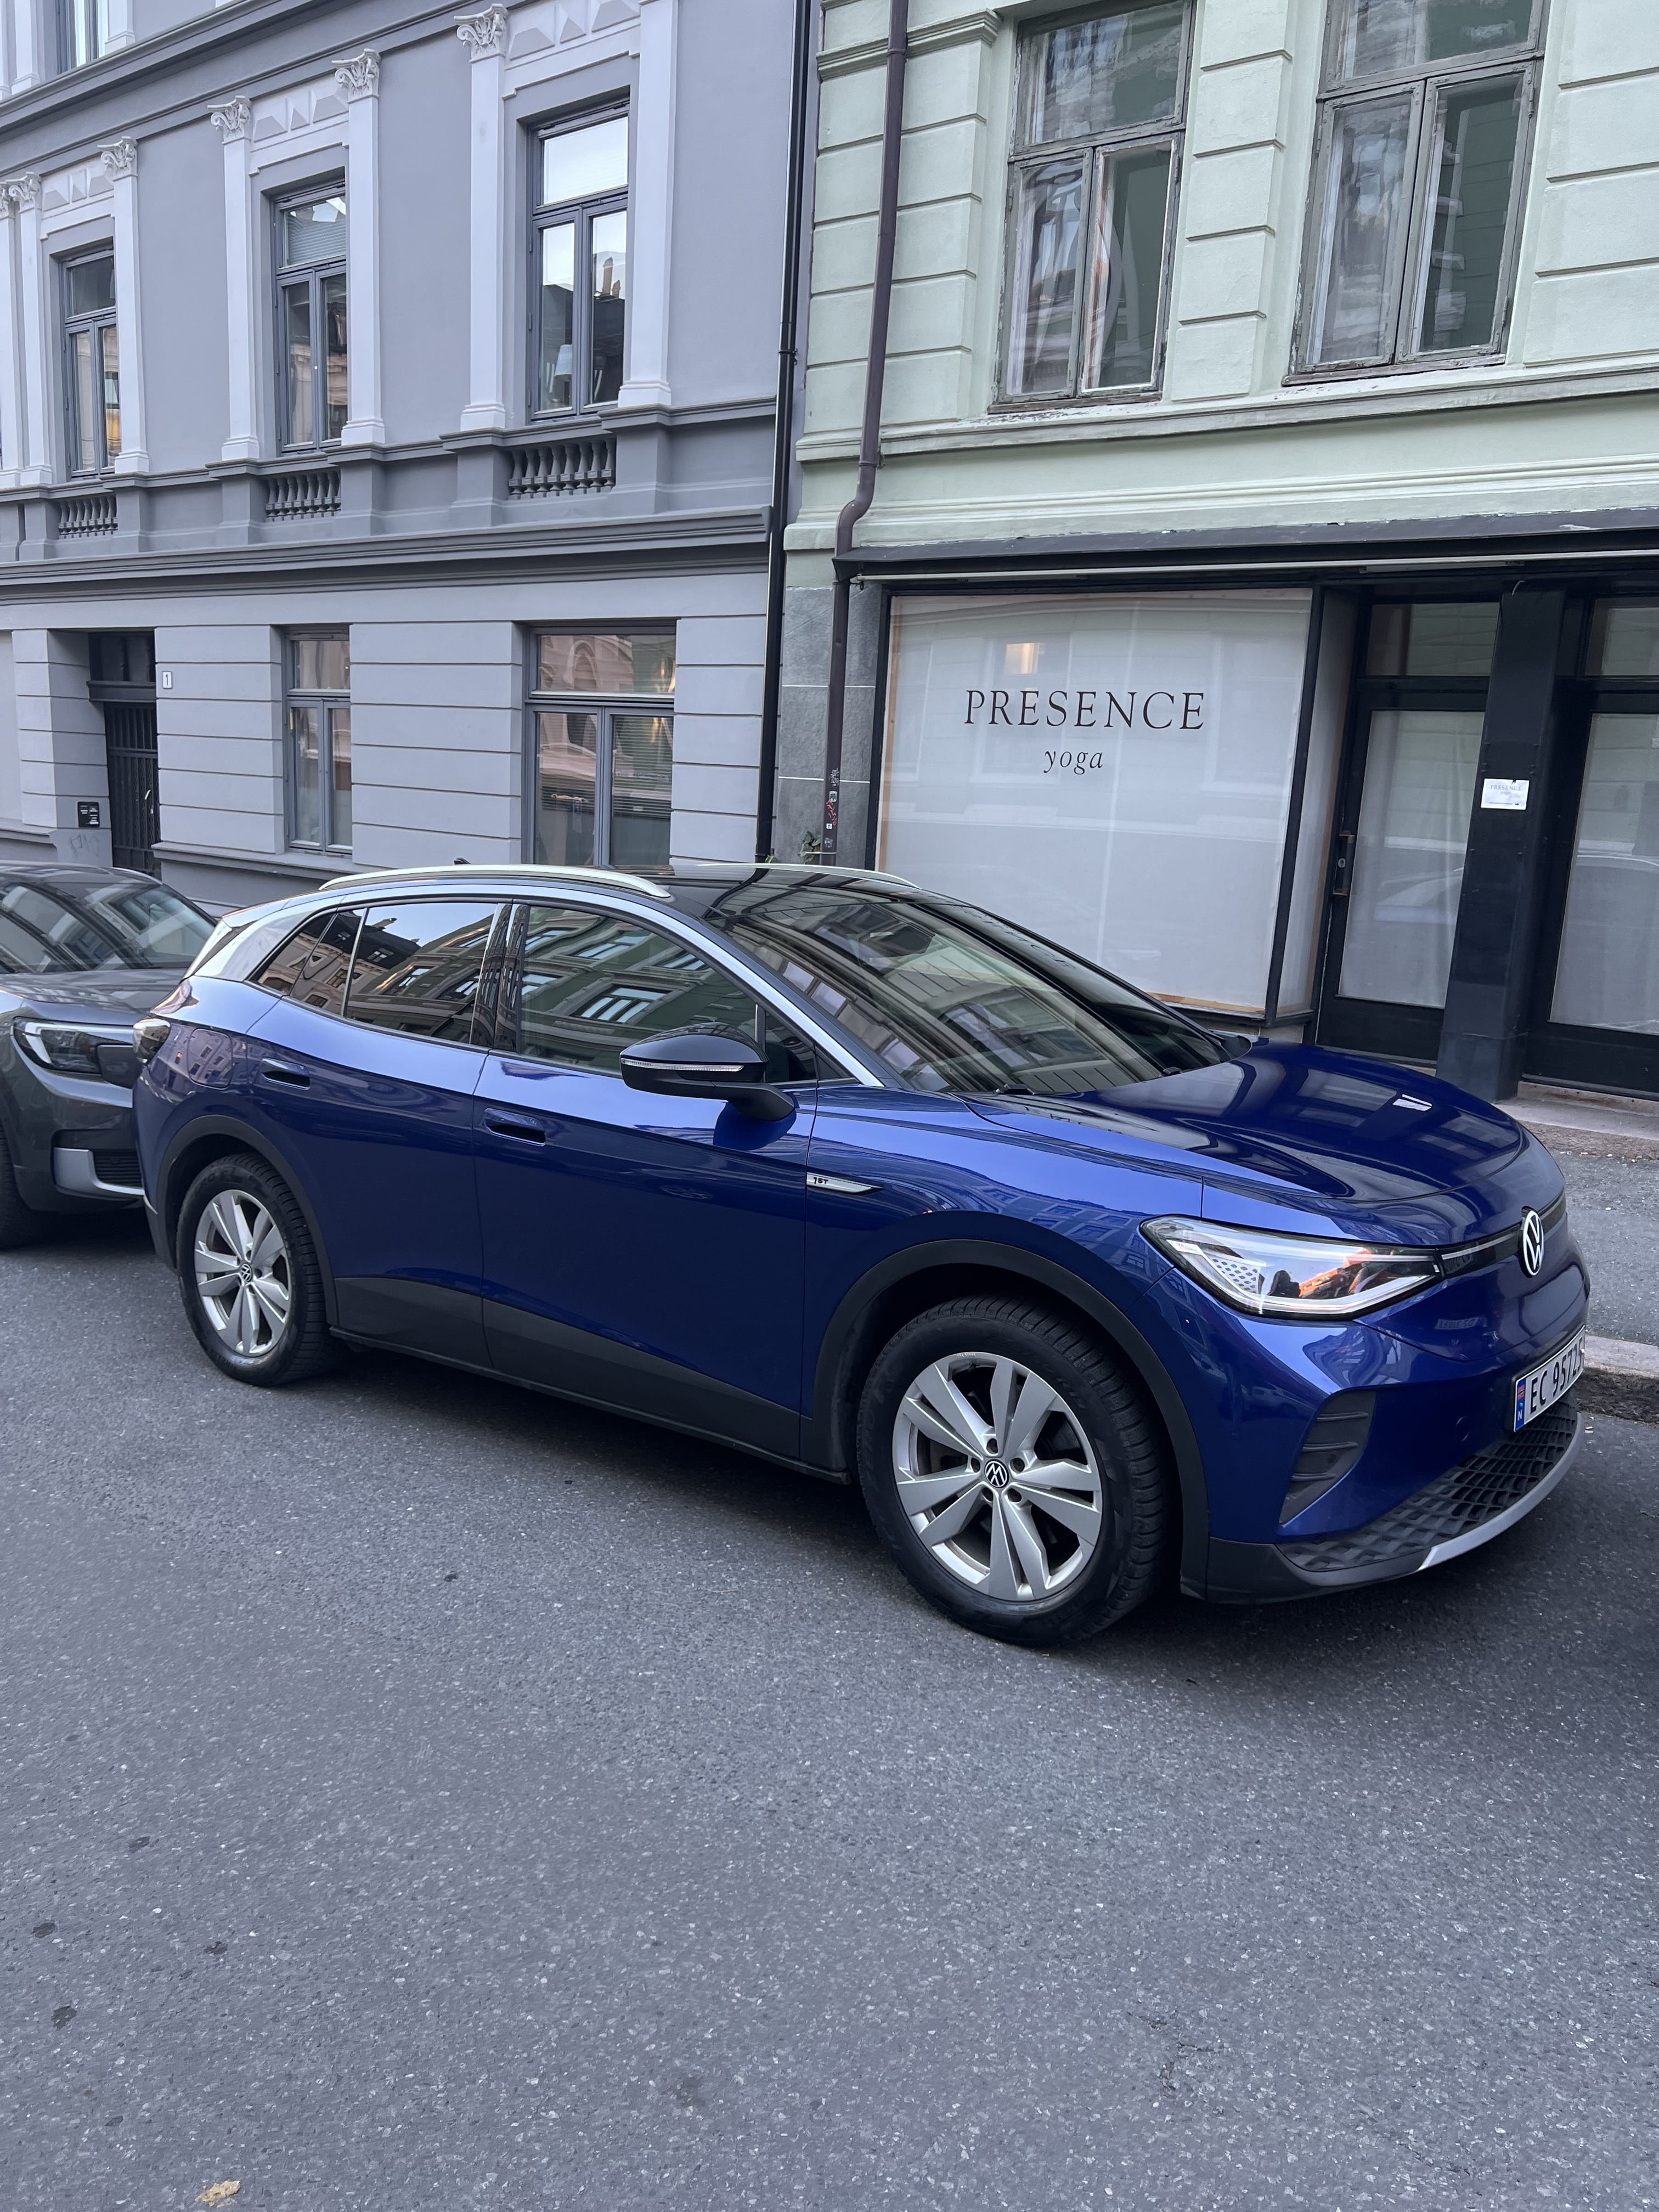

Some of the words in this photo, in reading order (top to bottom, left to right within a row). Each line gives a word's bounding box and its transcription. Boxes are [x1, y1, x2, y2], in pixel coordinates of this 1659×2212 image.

[964, 690, 1204, 730] PRESENCE
[1043, 751, 1103, 775] yoga
[1530, 1369, 1548, 1414] EC
[1517, 1409, 1523, 1421] N
